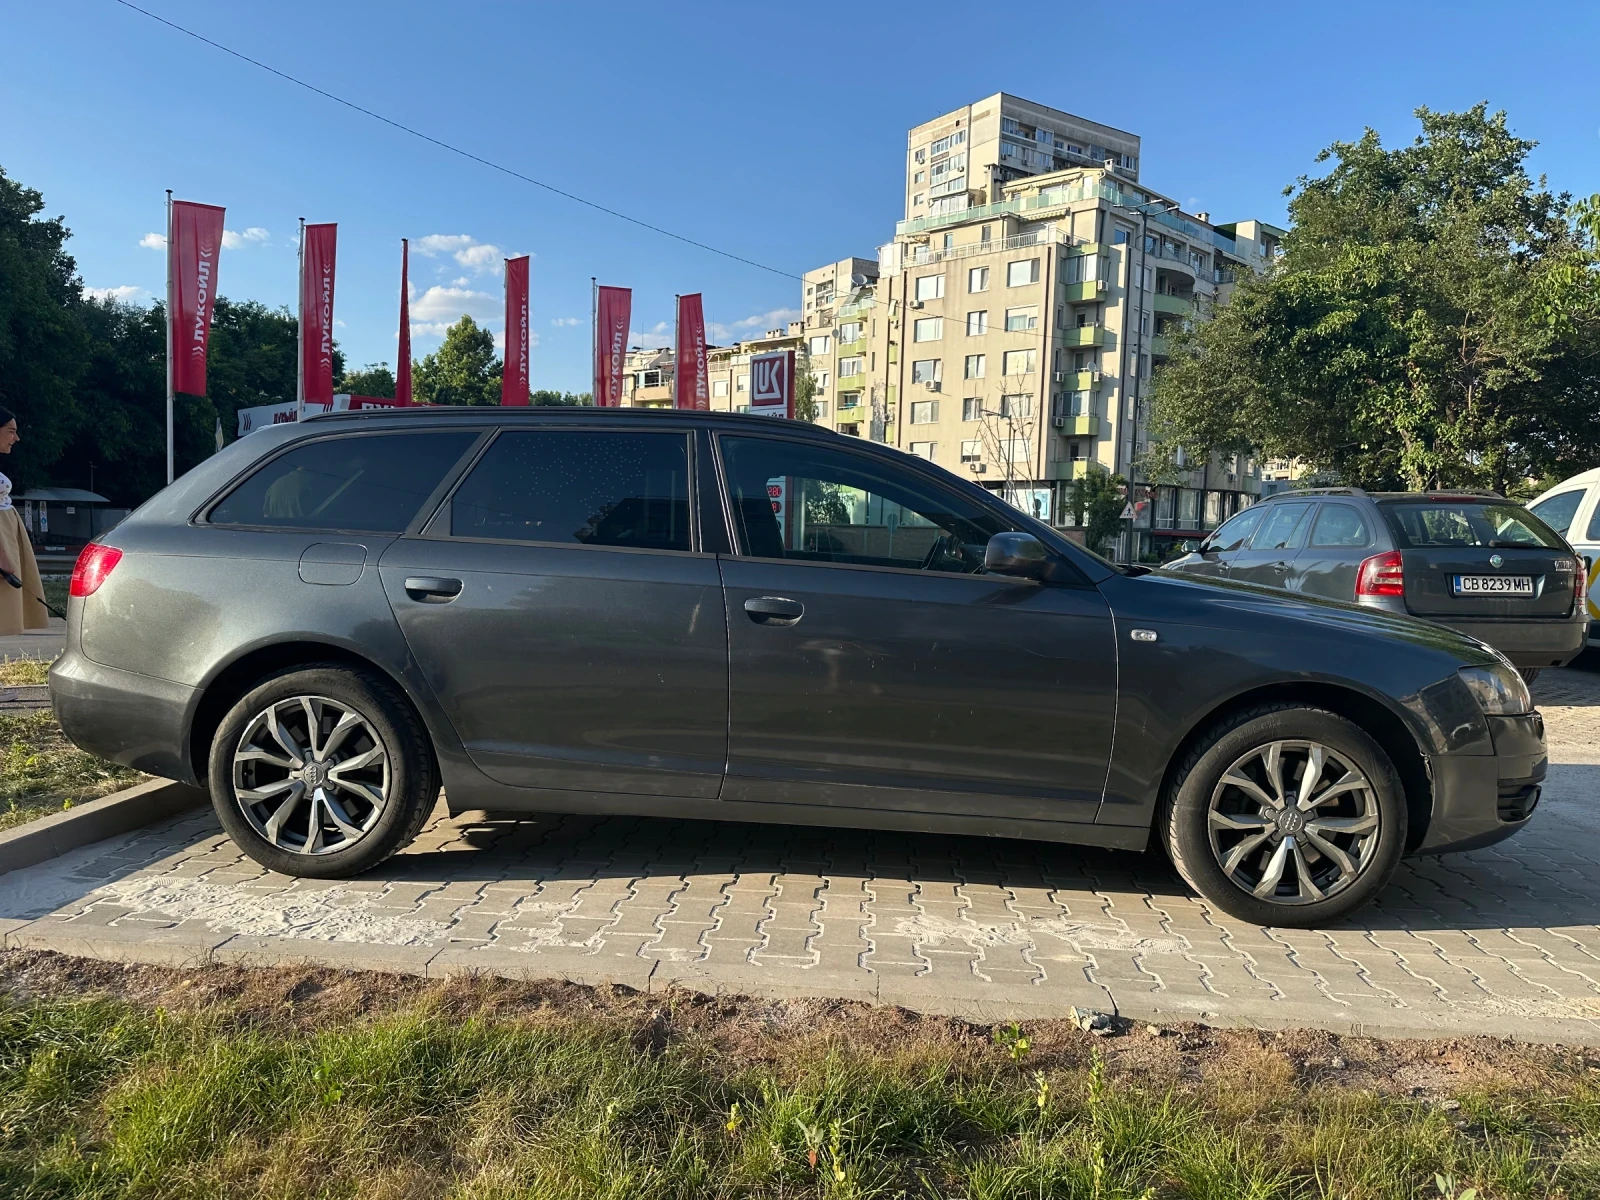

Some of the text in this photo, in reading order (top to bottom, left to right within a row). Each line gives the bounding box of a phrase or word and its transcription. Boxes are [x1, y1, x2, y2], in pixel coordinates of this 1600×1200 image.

[193, 260, 211, 344] ЛУКОЙЛ
[321, 277, 331, 355] ЛУКОЙЛ
[519, 305, 527, 374] ЛУКОЙЛ
[611, 332, 623, 396] ЛУКОЙЛ
[695, 337, 706, 398] ЛУКОЙЛ
[1463, 577, 1530, 591] CB 8239 MH
